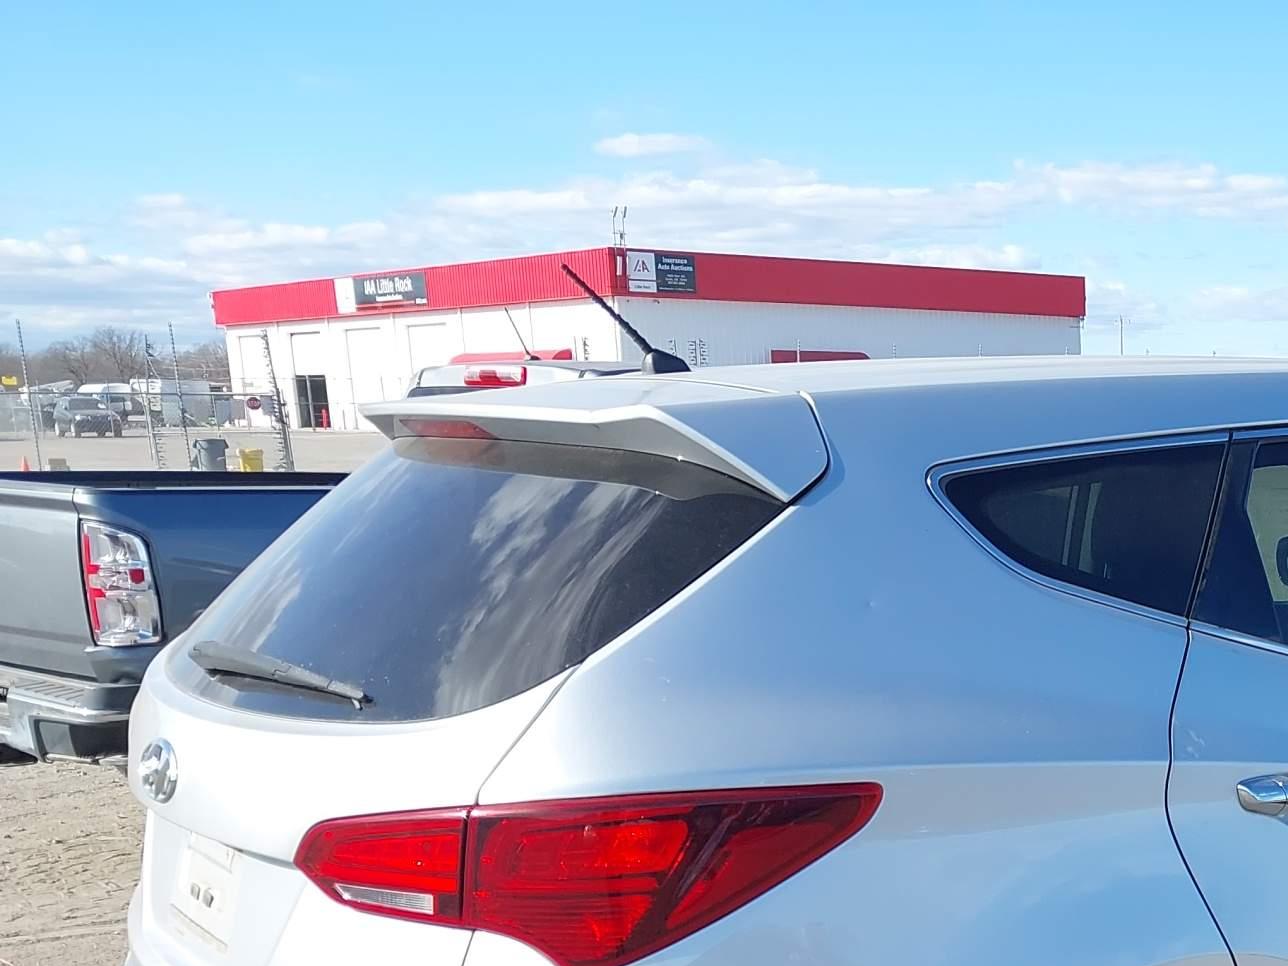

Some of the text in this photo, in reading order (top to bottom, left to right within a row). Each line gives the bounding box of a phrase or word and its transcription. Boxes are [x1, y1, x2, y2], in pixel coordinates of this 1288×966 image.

[363, 276, 414, 295] IAA Little Rock
